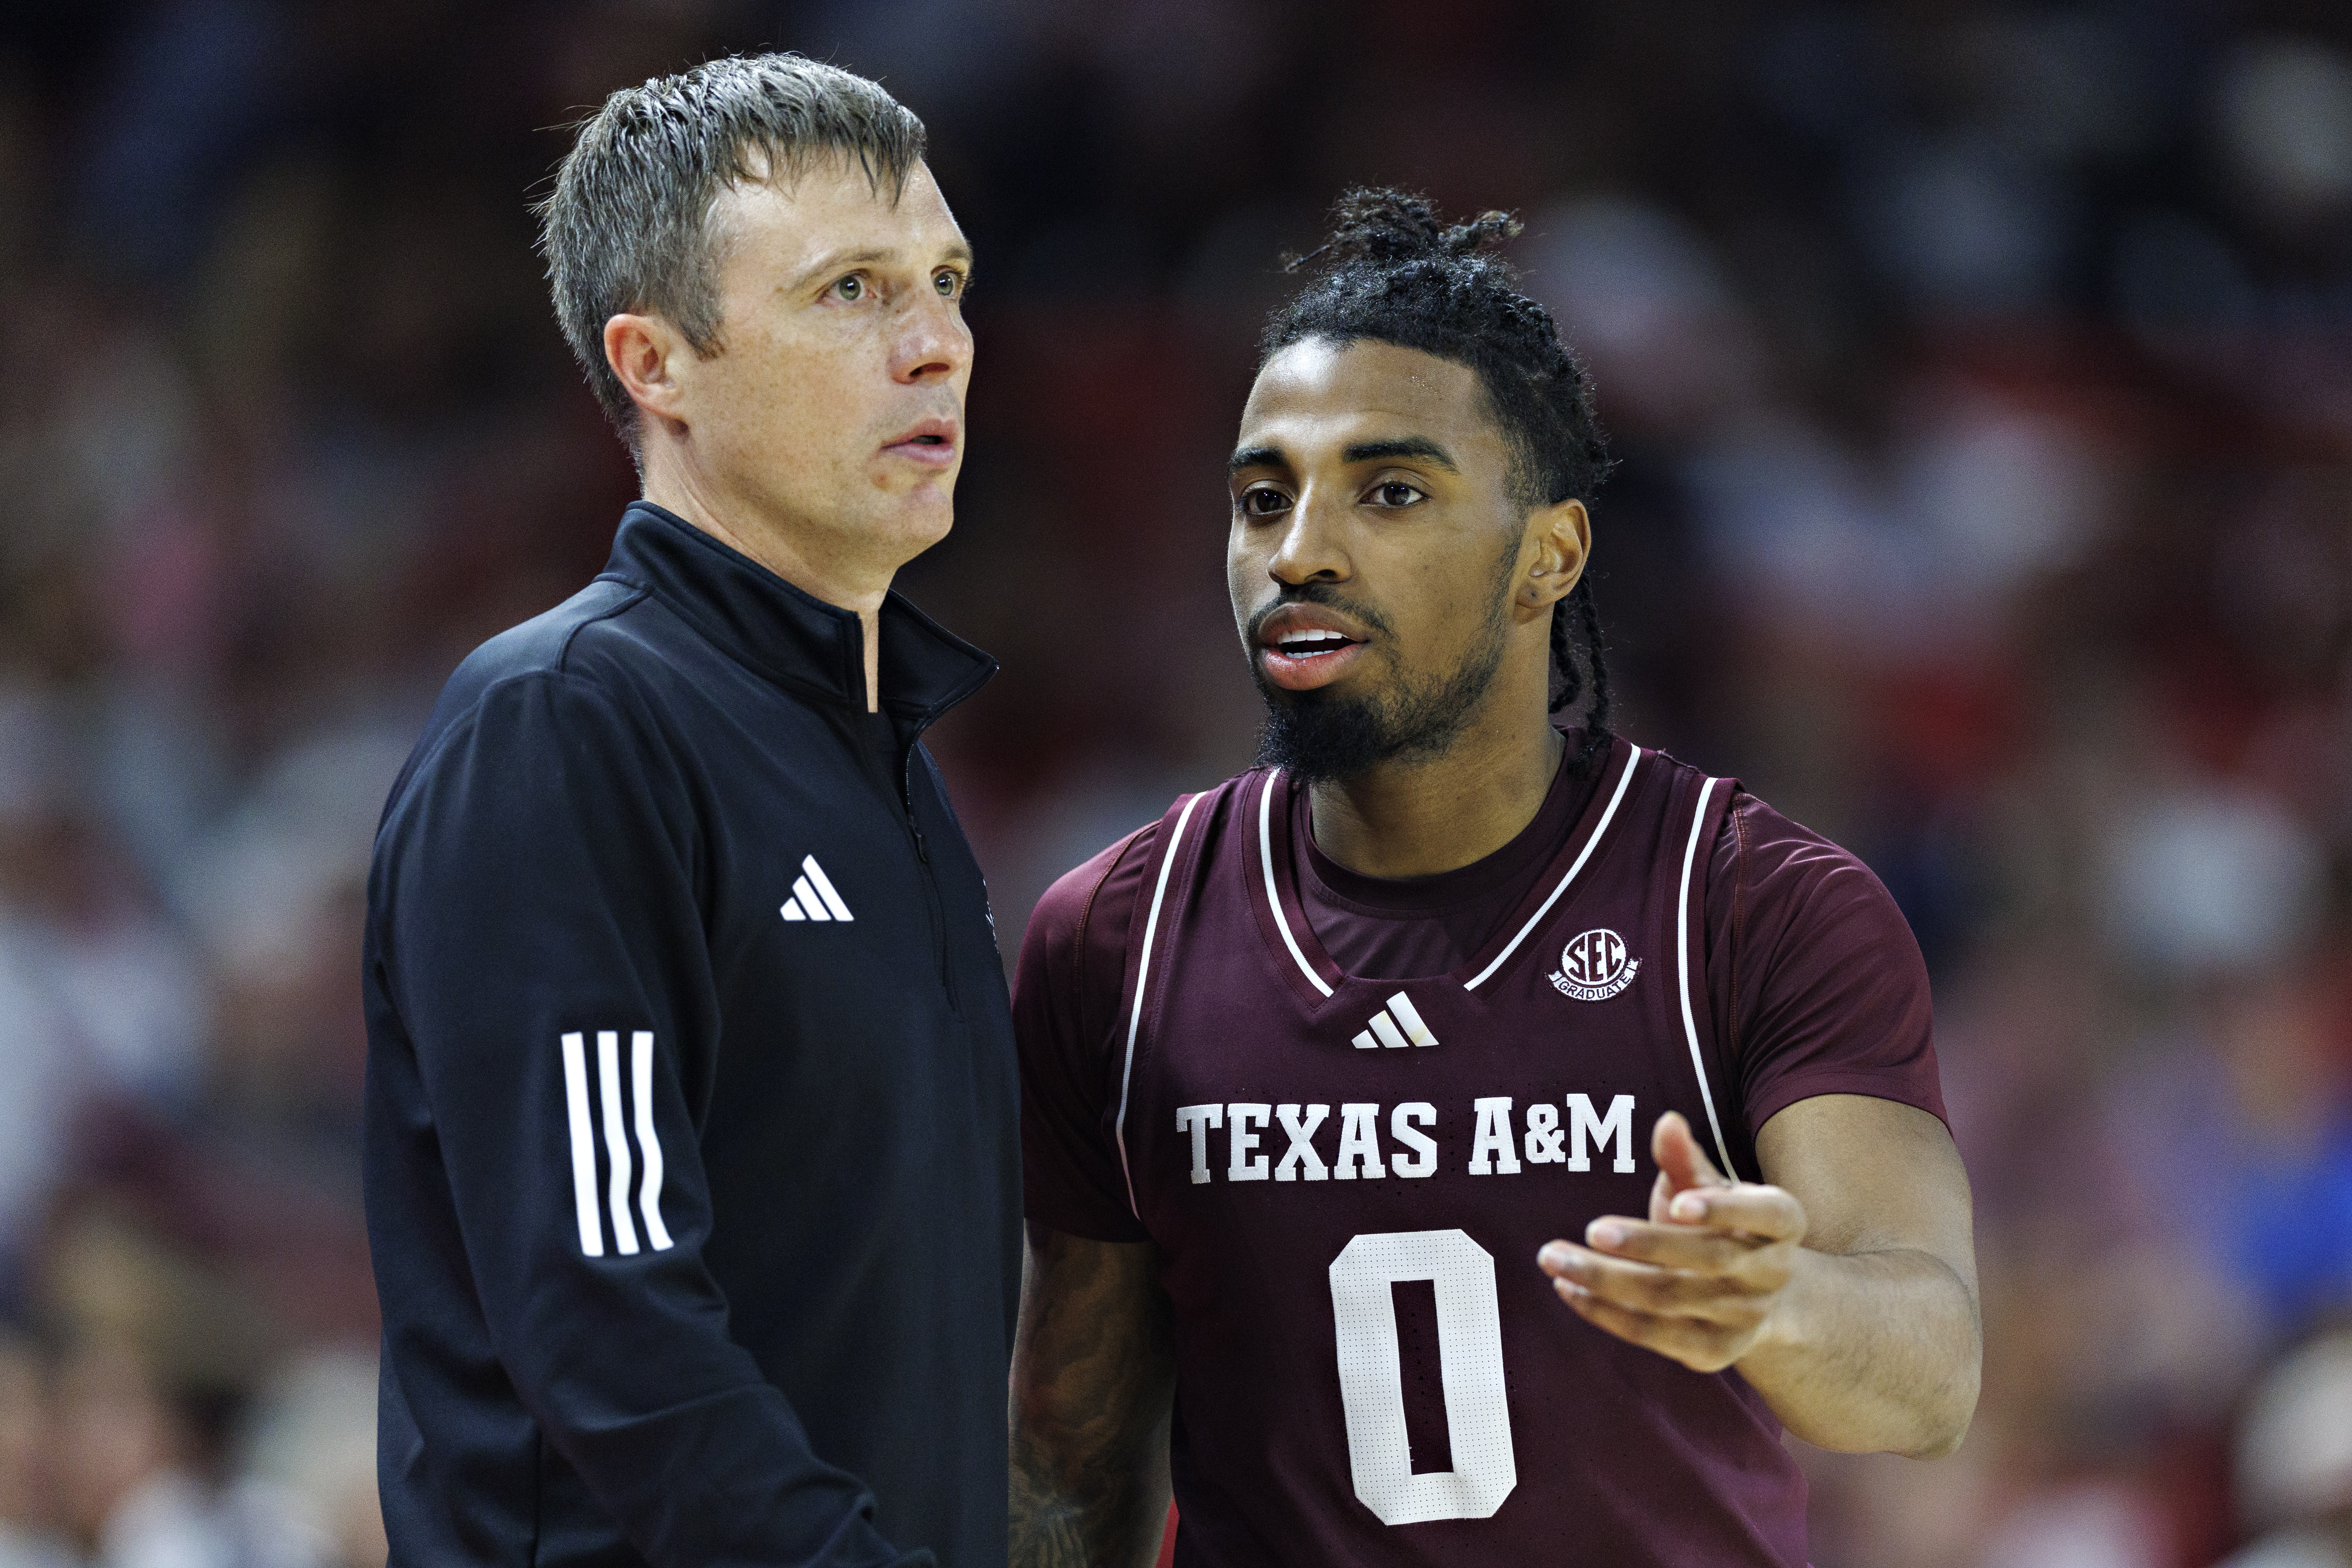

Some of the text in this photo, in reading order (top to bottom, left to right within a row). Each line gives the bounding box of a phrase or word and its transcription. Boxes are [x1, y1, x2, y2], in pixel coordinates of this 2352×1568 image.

[1558, 974, 1631, 999] GRADUATE
[1566, 932, 1621, 982] SEC
[1176, 1093, 1635, 1184] TEXAS A&M
[1329, 1229, 1517, 1526] 0
